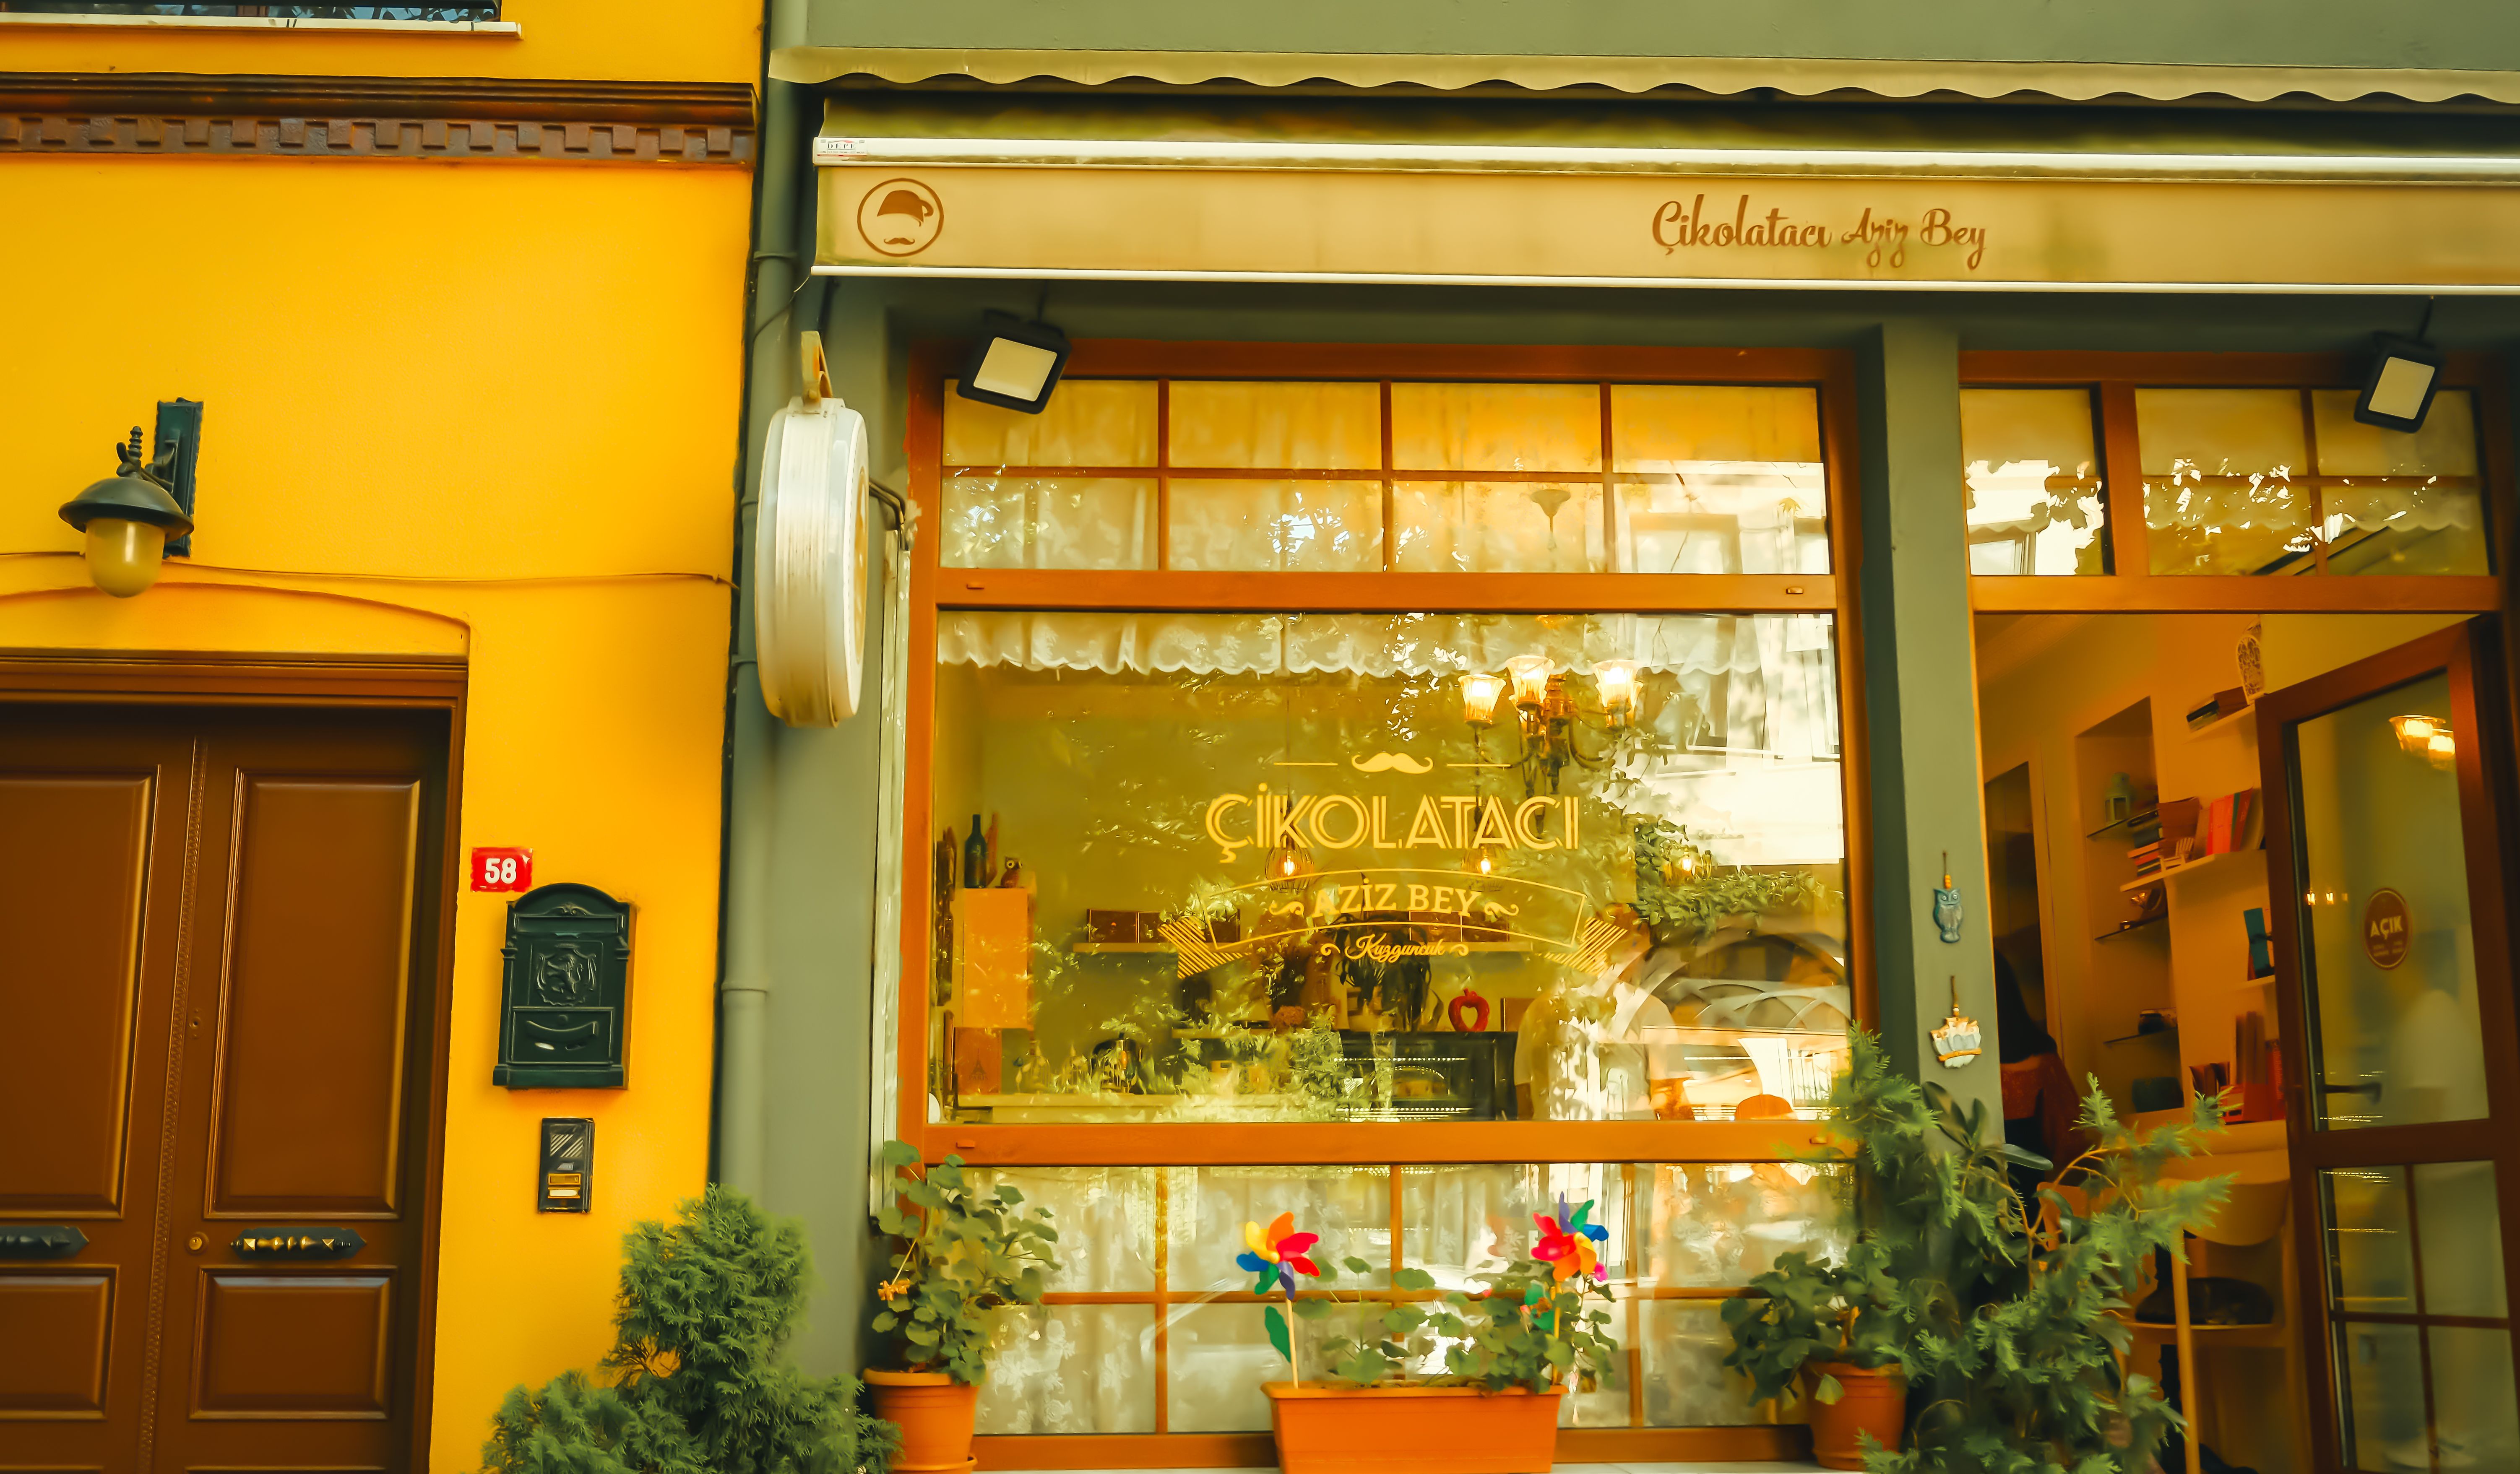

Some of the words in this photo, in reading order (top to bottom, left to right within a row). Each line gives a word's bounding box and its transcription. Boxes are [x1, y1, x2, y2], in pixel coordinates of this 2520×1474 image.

[1652, 194, 1833, 256] Çikolatacı
[1841, 208, 1909, 268] Aziz
[1920, 208, 1987, 270] Bey
[1205, 782, 1580, 864] ÇİKOLATACI
[484, 858, 517, 884] 58
[1311, 878, 1397, 918] AZİZ
[1407, 883, 1481, 917] BEY
[2370, 915, 2403, 940] AÇIK
[1344, 932, 1445, 963] Kuzguncuk
